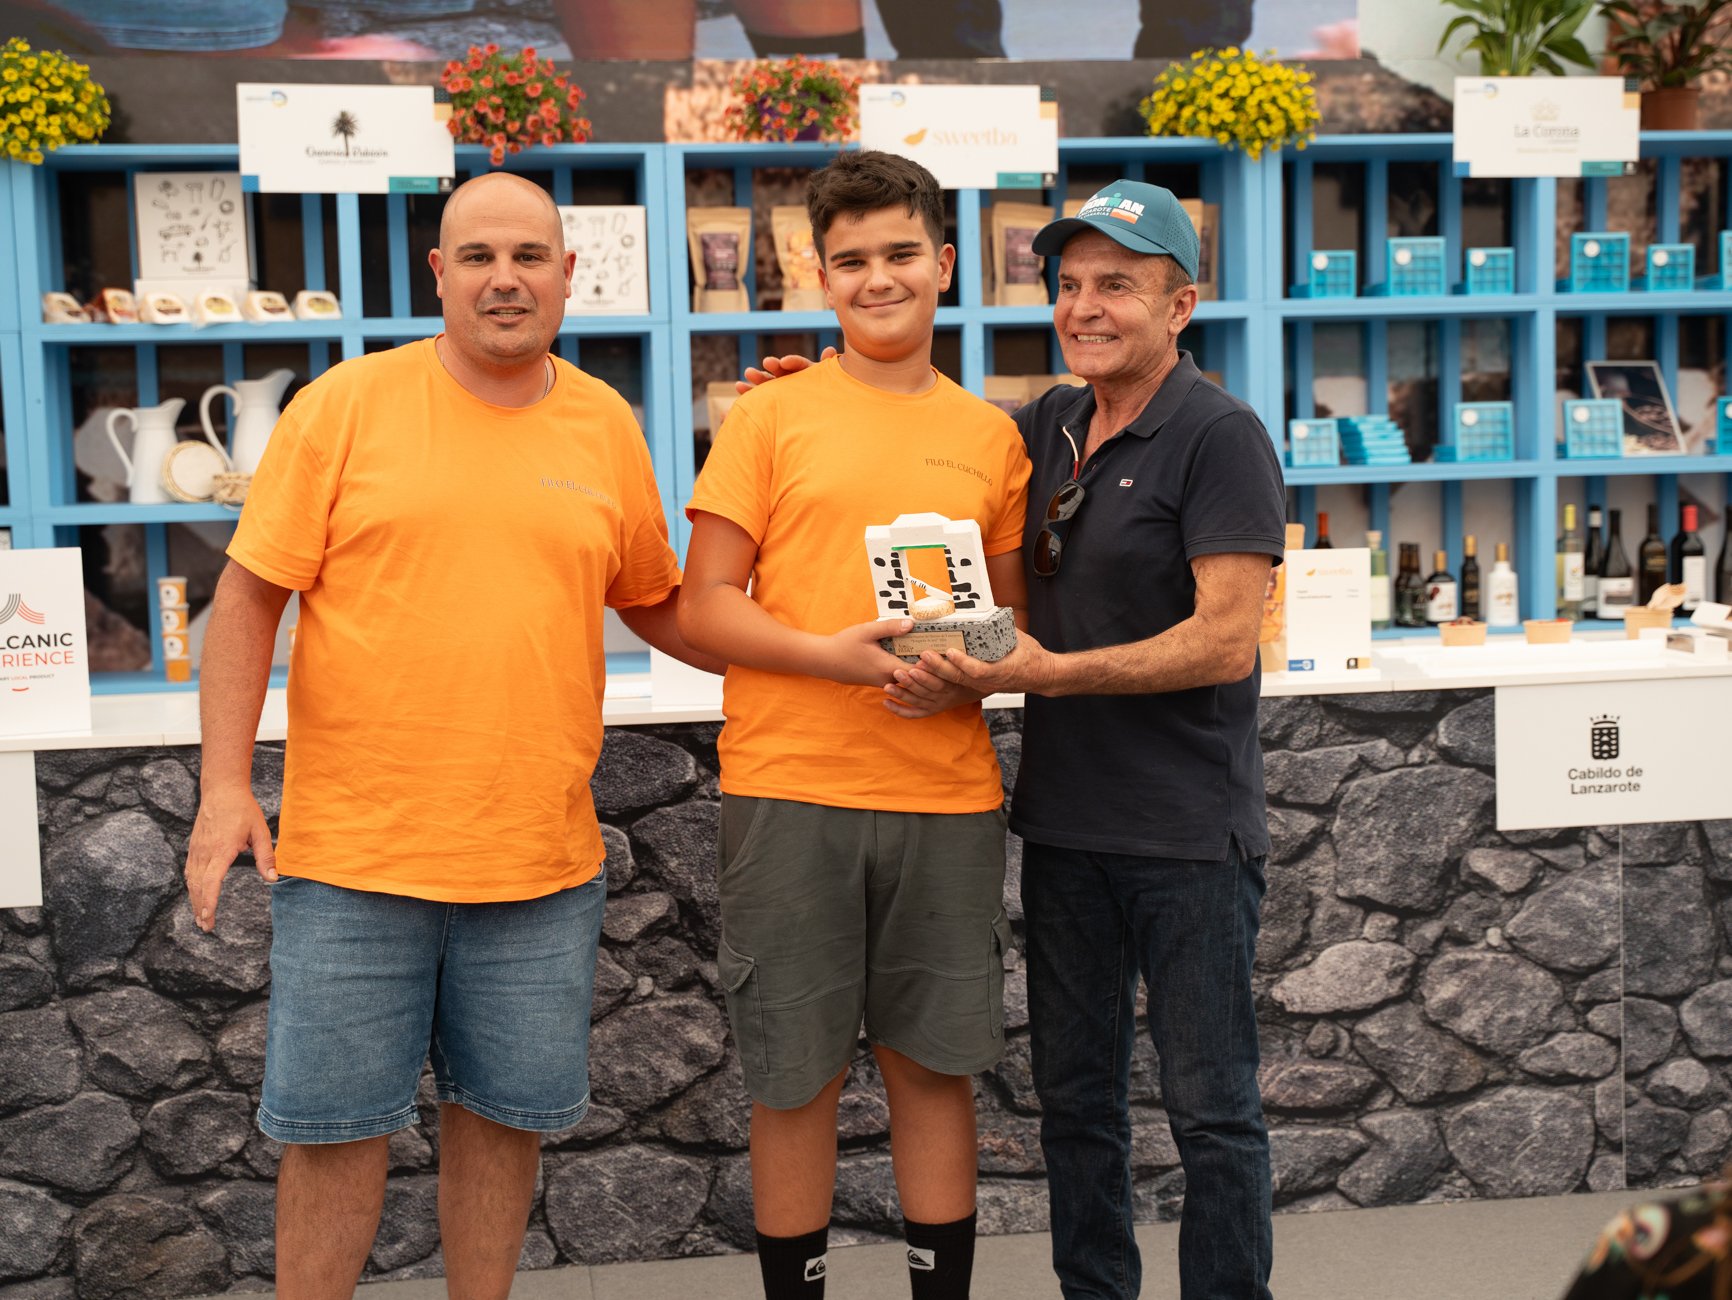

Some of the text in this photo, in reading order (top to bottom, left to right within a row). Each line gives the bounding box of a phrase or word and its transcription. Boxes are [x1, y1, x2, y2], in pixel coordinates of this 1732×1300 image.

[1514, 126, 1529, 138] La
[946, 460, 957, 469] EL
[2, 650, 75, 668] RIENCE
[1568, 766, 1643, 780] Cabildo de
[1570, 781, 1642, 795] Lanzarote
